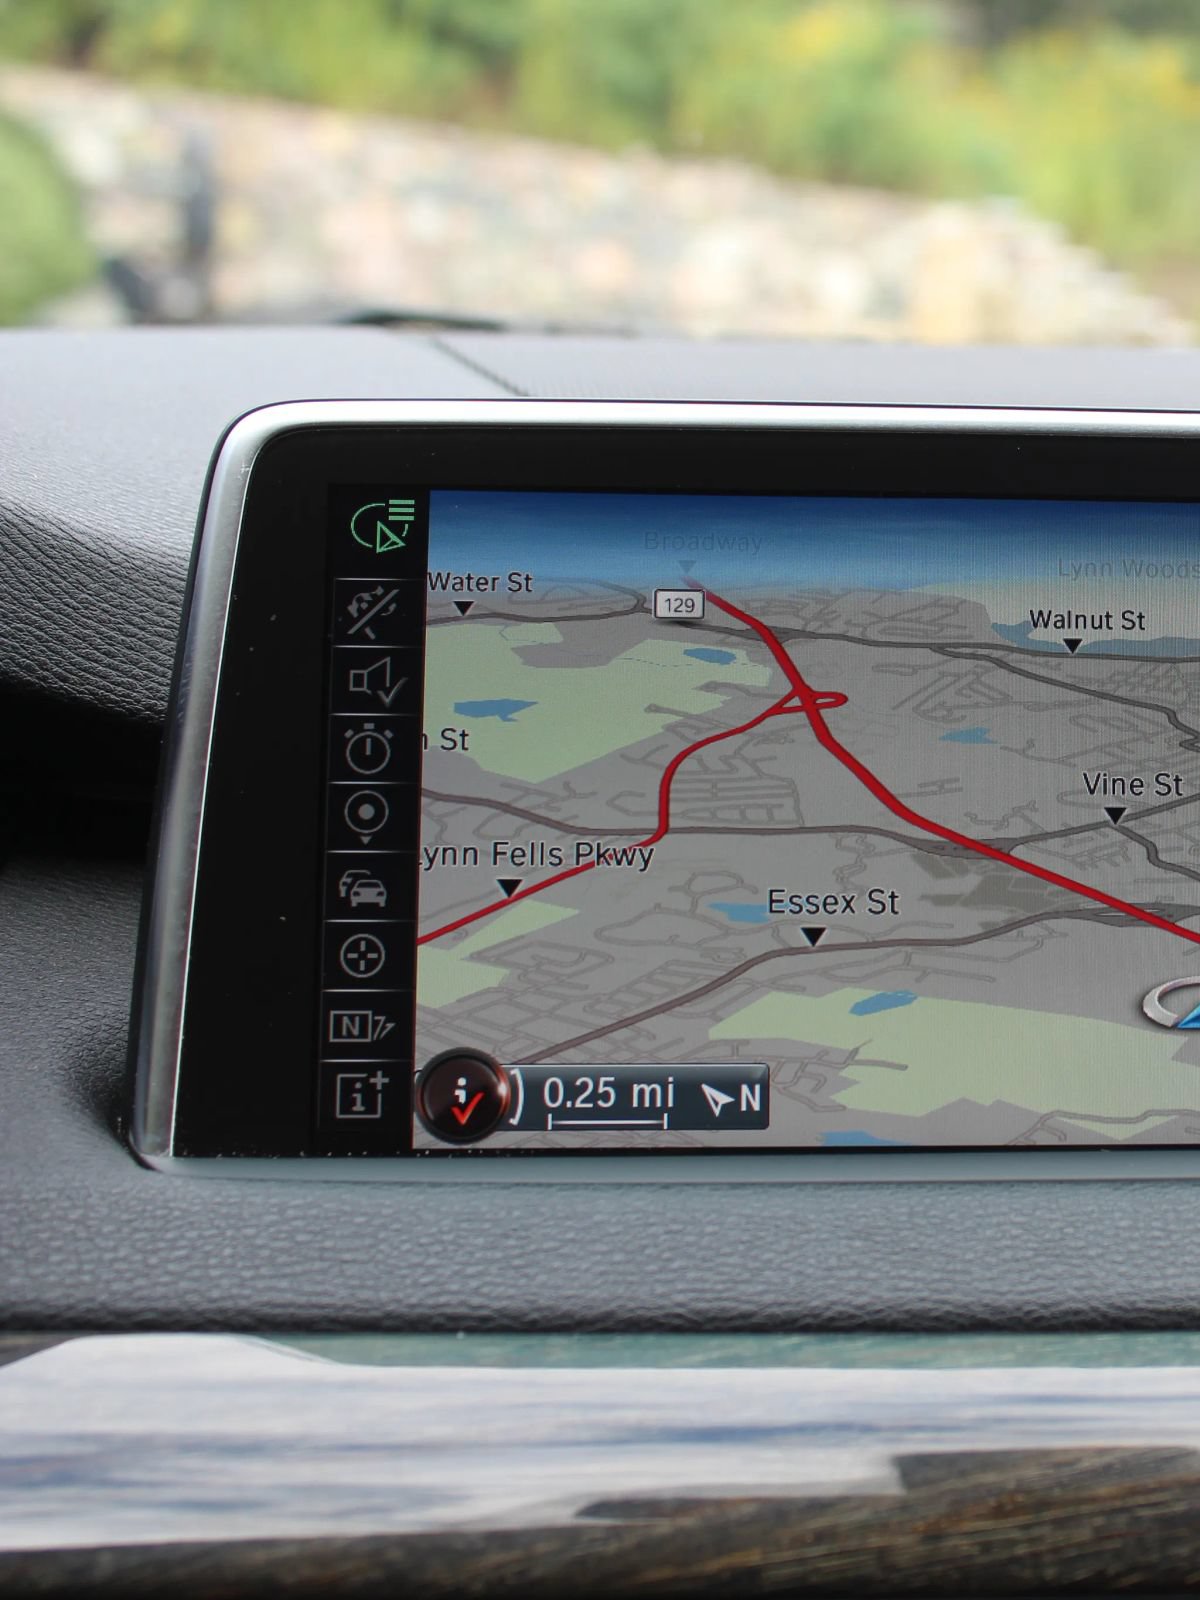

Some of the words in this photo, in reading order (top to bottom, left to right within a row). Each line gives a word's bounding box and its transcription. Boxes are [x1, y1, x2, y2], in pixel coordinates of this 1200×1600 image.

[645, 532, 763, 556] Broadway
[1058, 558, 1113, 581] Lynn
[427, 572, 500, 592] Water
[507, 572, 533, 592] St
[664, 598, 696, 613] 129
[1030, 609, 1113, 630] Walnut
[1121, 610, 1146, 631] St
[440, 727, 469, 751] St
[1083, 772, 1145, 796] Vine
[1154, 773, 1184, 797] St
[418, 846, 479, 871] ynn
[492, 841, 563, 866] Fells
[575, 842, 655, 871] Pkwy
[769, 888, 857, 915] Essex
[867, 888, 900, 916] St
[543, 1076, 617, 1108] 0.25
[632, 1076, 675, 1108] mi
[740, 1084, 762, 1112] N
